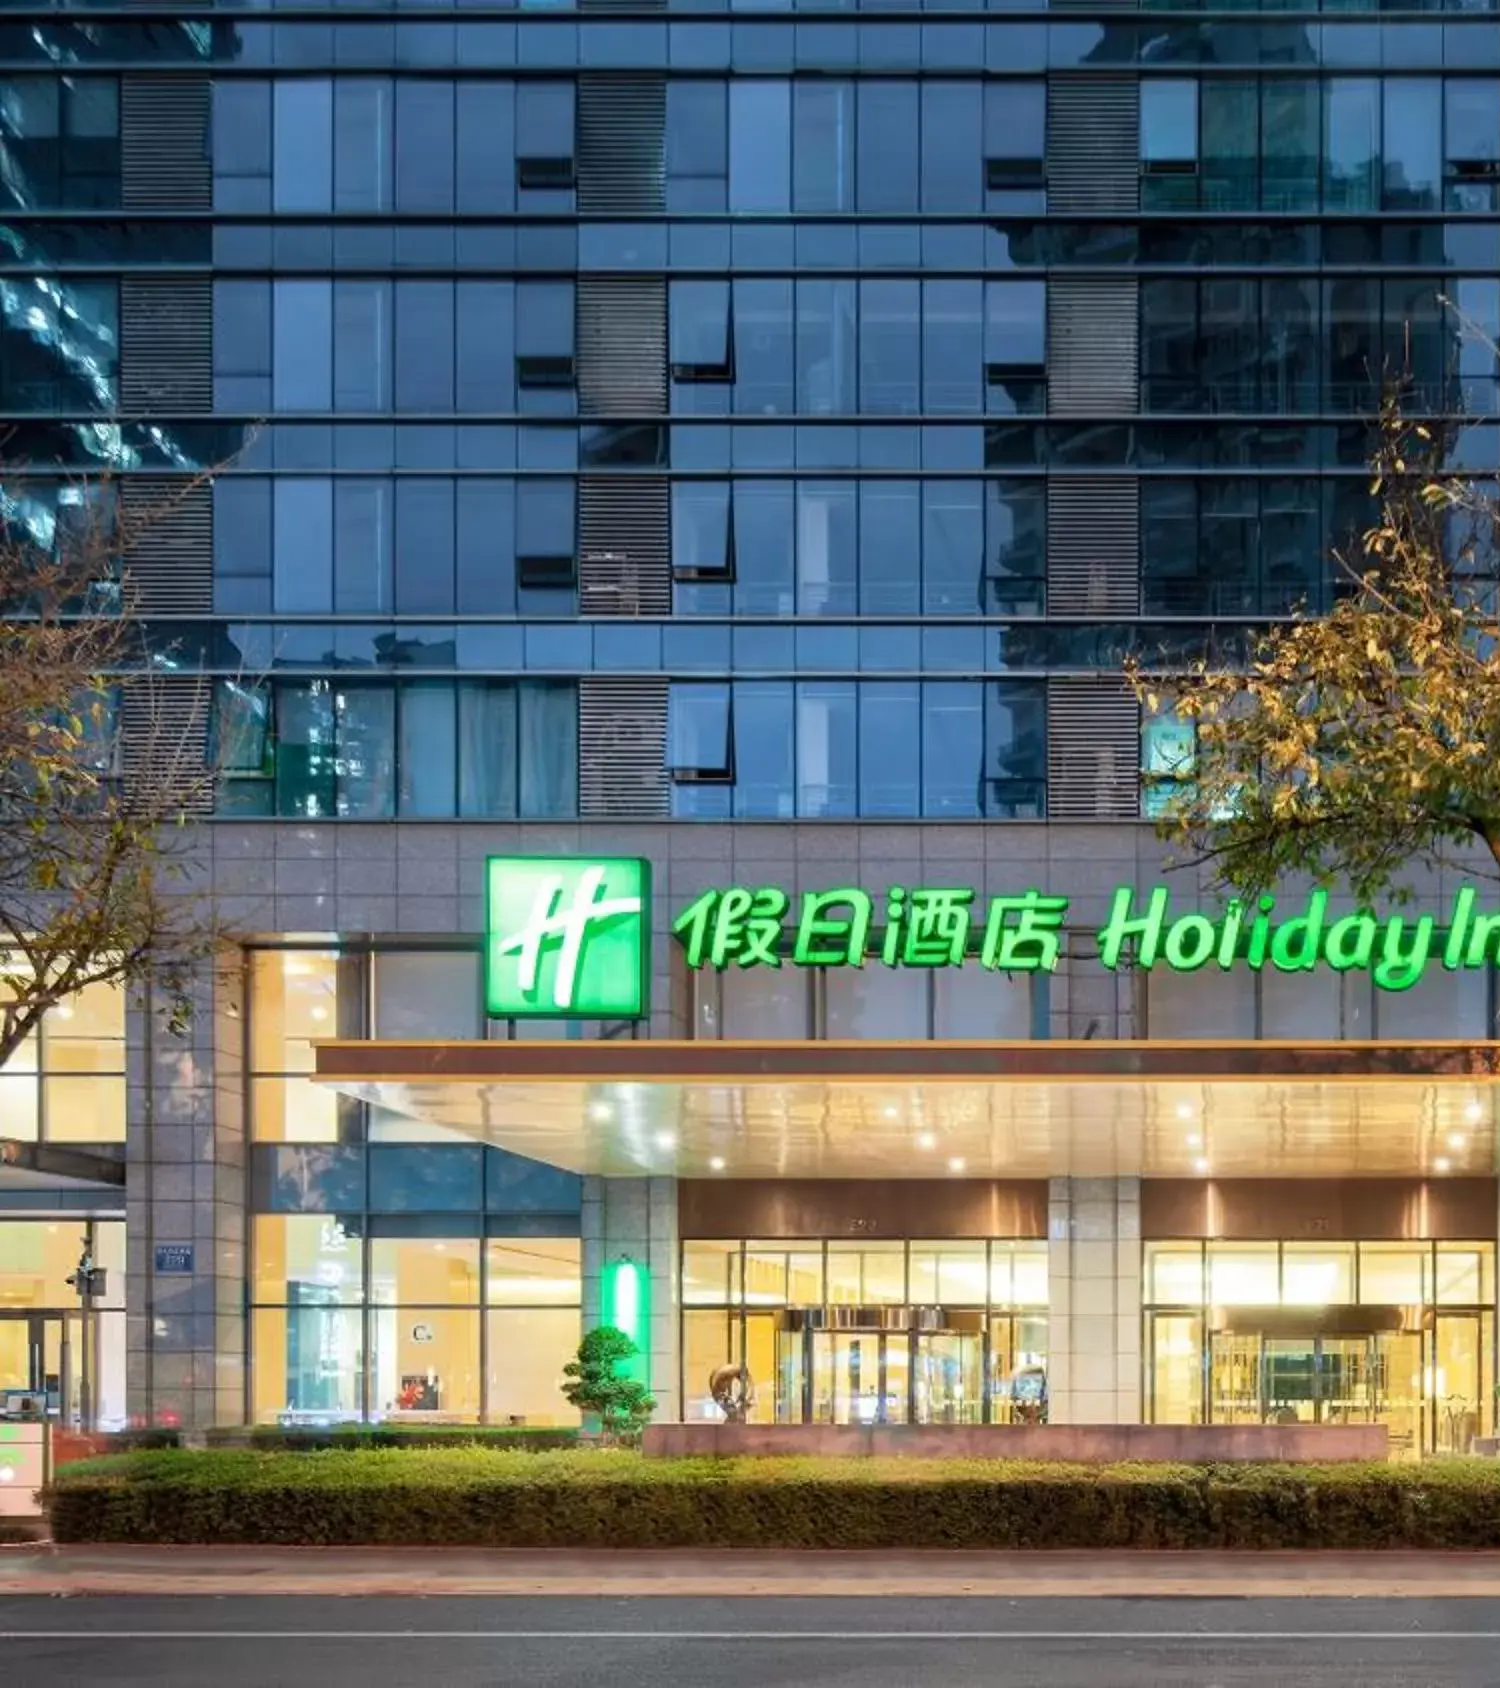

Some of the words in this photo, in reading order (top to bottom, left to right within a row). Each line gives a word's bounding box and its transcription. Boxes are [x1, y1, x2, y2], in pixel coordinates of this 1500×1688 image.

[672, 886, 1069, 973] 假日酒店
[1098, 885, 1434, 992] Holiday
